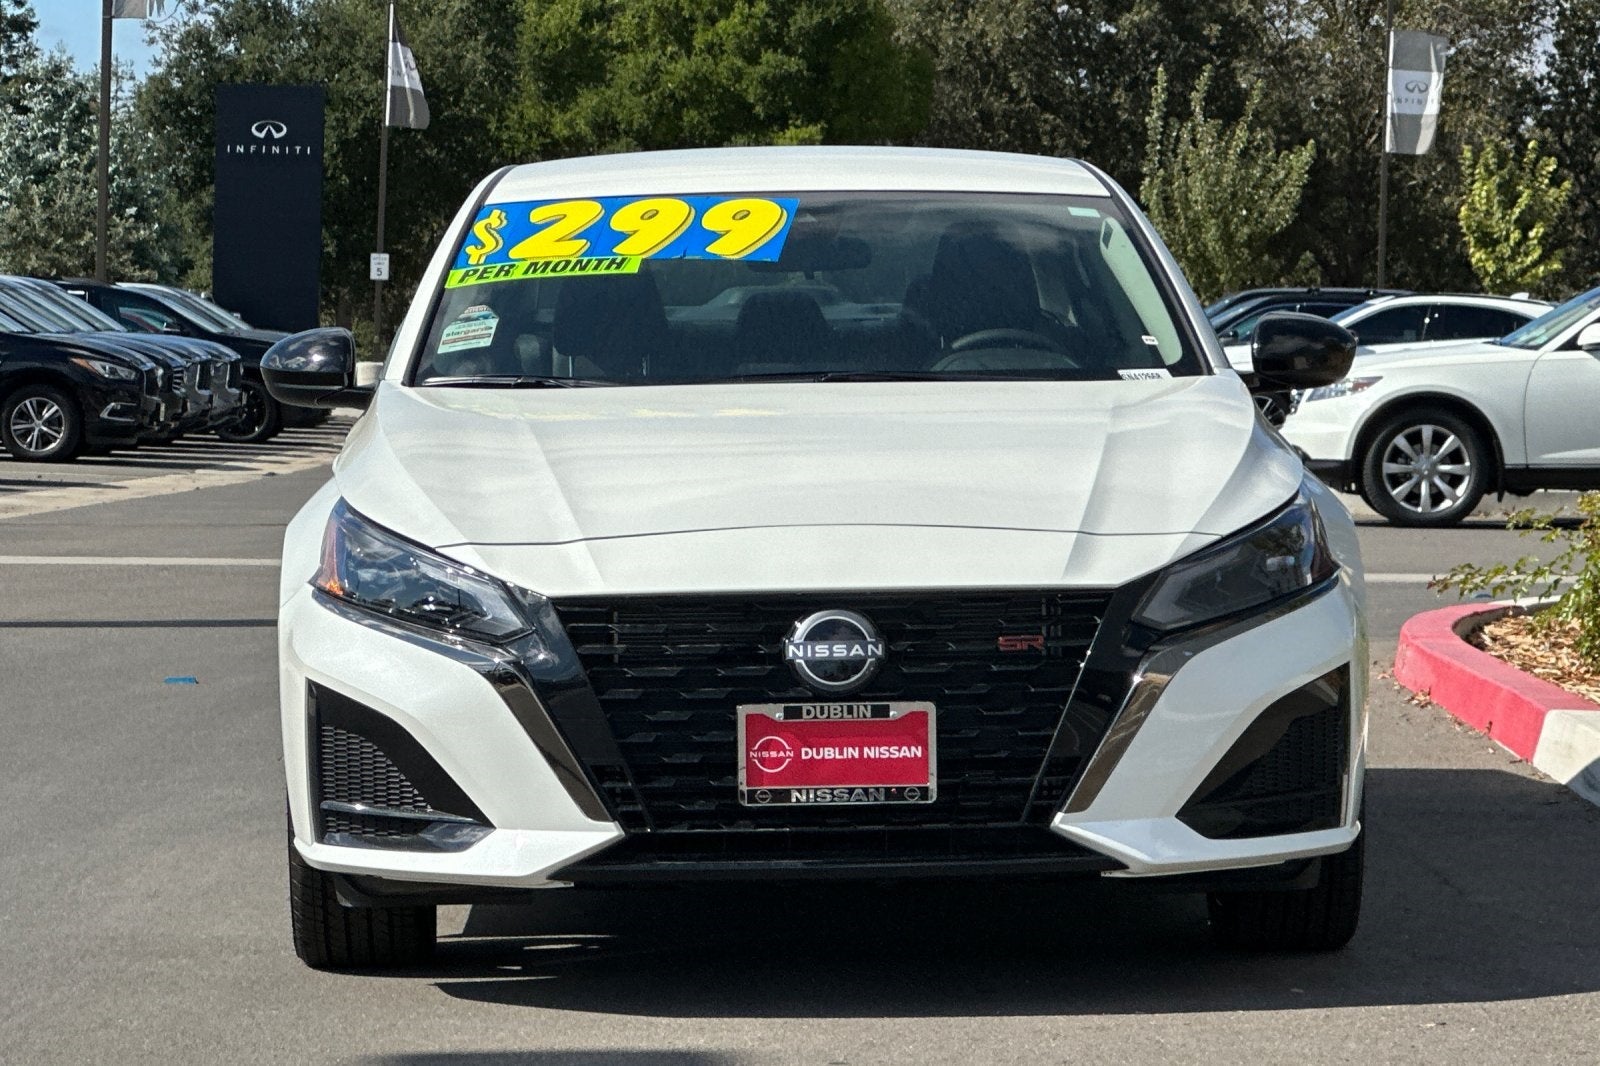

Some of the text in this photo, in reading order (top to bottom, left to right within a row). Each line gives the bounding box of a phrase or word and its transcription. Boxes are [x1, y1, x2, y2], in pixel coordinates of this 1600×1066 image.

[226, 143, 311, 155] INFINITI
[464, 197, 789, 265] $299
[376, 266, 383, 277] 5
[457, 256, 632, 284] PER MONTH
[997, 634, 1045, 651] SR
[787, 643, 883, 658] NISSAN
[801, 704, 872, 719] DUBLIN
[749, 750, 794, 758] NISSAN
[801, 745, 922, 760] DUBLIN NISSAN
[790, 788, 886, 803] NISSAN
